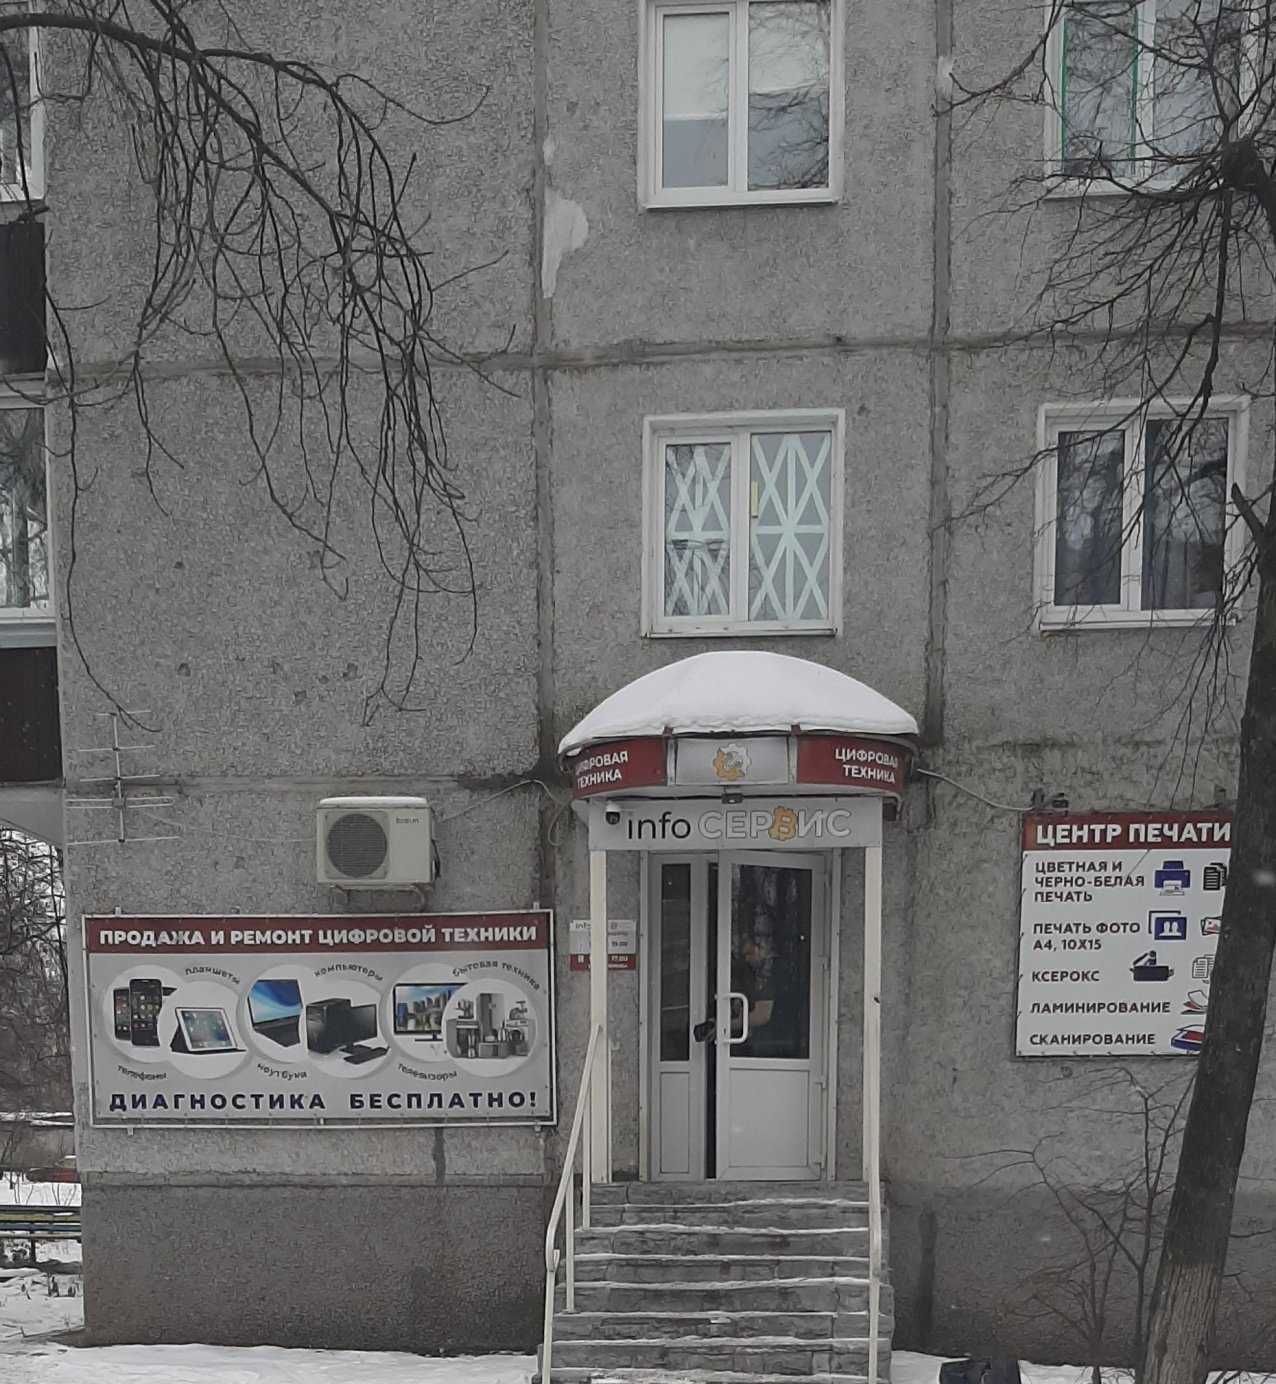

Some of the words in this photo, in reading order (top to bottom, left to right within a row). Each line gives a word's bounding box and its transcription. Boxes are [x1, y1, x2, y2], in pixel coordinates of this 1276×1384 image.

[577, 768, 623, 790] ТЕХНИКА
[842, 764, 896, 784] ТЕХНИКА
[627, 811, 692, 840] info
[698, 805, 852, 842] СЕРВИС
[1036, 824, 1122, 846] ЦЕНТР
[1129, 822, 1231, 843] ПЕЧАТИ
[1035, 861, 1108, 874] ЦВЕТНАЯ
[1112, 861, 1122, 872] И
[1035, 876, 1145, 888] ЧЕРНО-БЕЛАЯ
[1034, 891, 1093, 902] ПЕЧАТЬ
[99, 930, 205, 946] ПРОДАЖА
[211, 930, 225, 944] И
[230, 930, 313, 945] РЕМОНТ
[318, 927, 436, 945] ЦИФРОВОЙ
[441, 926, 537, 943] ТЕХНИКИ
[1033, 923, 1092, 934] ПЕЧАТЬ
[1096, 922, 1141, 934] ФОТО
[1033, 940, 1057, 952] А4,
[1062, 939, 1102, 950] 10Х15
[185, 966, 241, 985] планшеты
[314, 964, 384, 982] компьютеры
[452, 960, 499, 977] бытовая
[502, 962, 541, 991] техника
[1032, 971, 1100, 982] КСЕРОКС
[1030, 1002, 1171, 1014] ЛАМИНИРОВАНИЕ
[1029, 1034, 1156, 1045] СКАНИРОВАНИЕ
[117, 1064, 168, 1081] телефоны
[256, 1062, 308, 1081] ноутбуки
[397, 1063, 458, 1082] телевизоры
[109, 1093, 327, 1112] ДИАГНОСТИКА
[349, 1091, 538, 1110] БЕСПЛАТНО!
